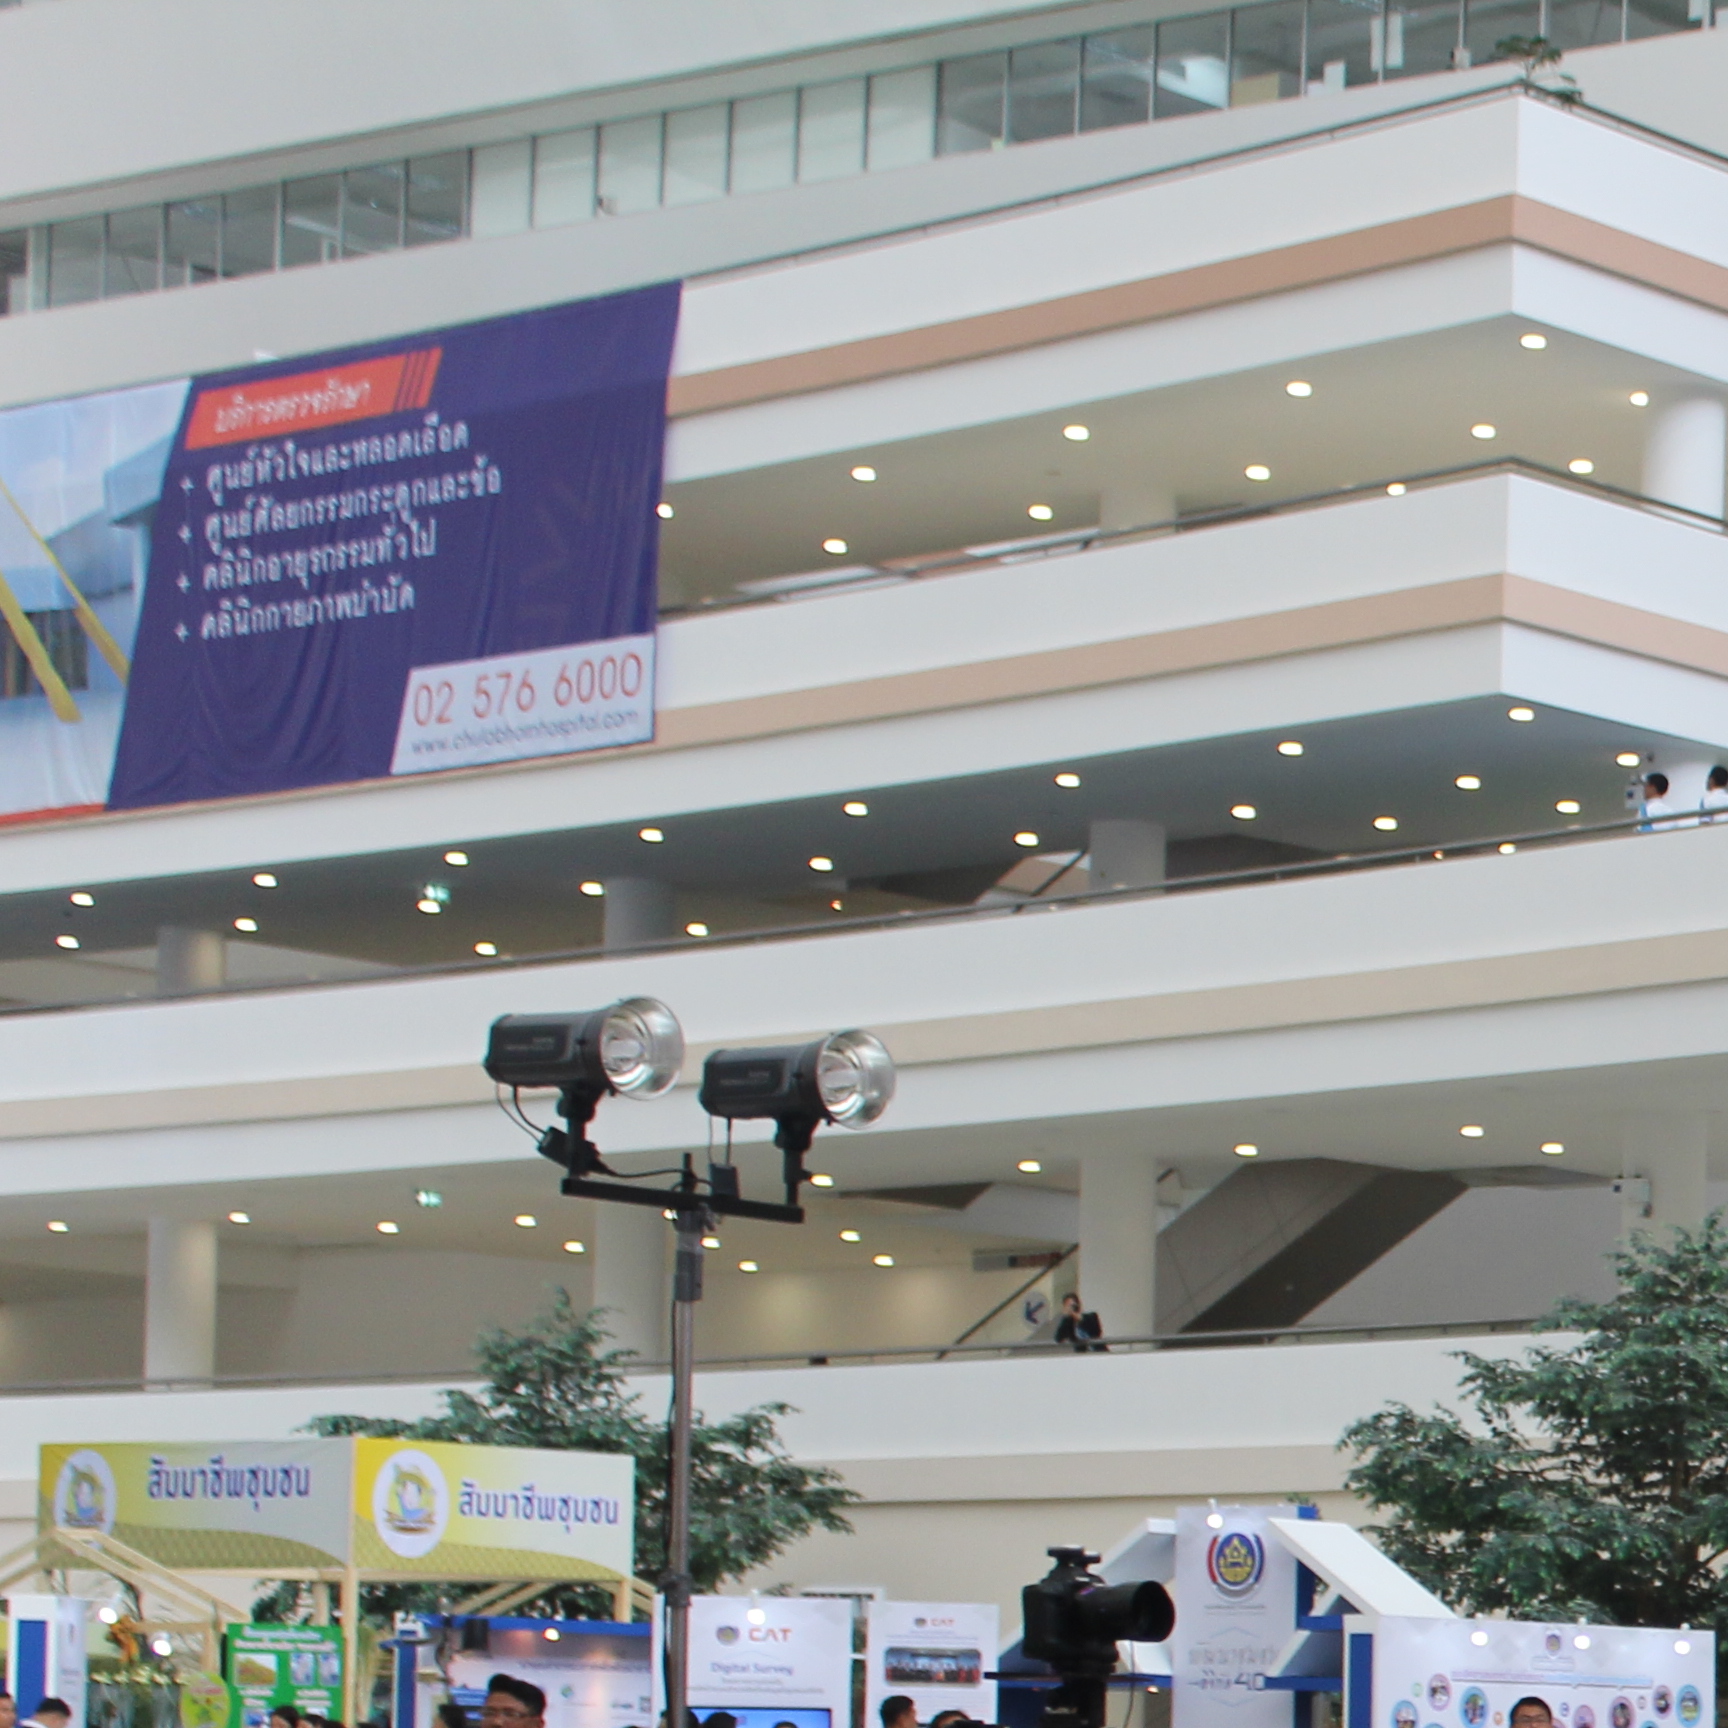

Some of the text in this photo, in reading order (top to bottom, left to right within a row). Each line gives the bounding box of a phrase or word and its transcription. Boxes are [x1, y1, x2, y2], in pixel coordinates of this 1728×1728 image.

[202, 517, 438, 591] คลินิกอายุรกรรมทั่วไป
[200, 574, 416, 640] คลินิกกายภาพบำบัด
[413, 651, 643, 727] 02 576 6000
[146, 1455, 311, 1512] สัมมาชีพชุมชน
[459, 1480, 620, 1536] สัมมาชีพชุมชน
[748, 1627, 793, 1643] CAT
[710, 1661, 793, 1677] Digital Survey
